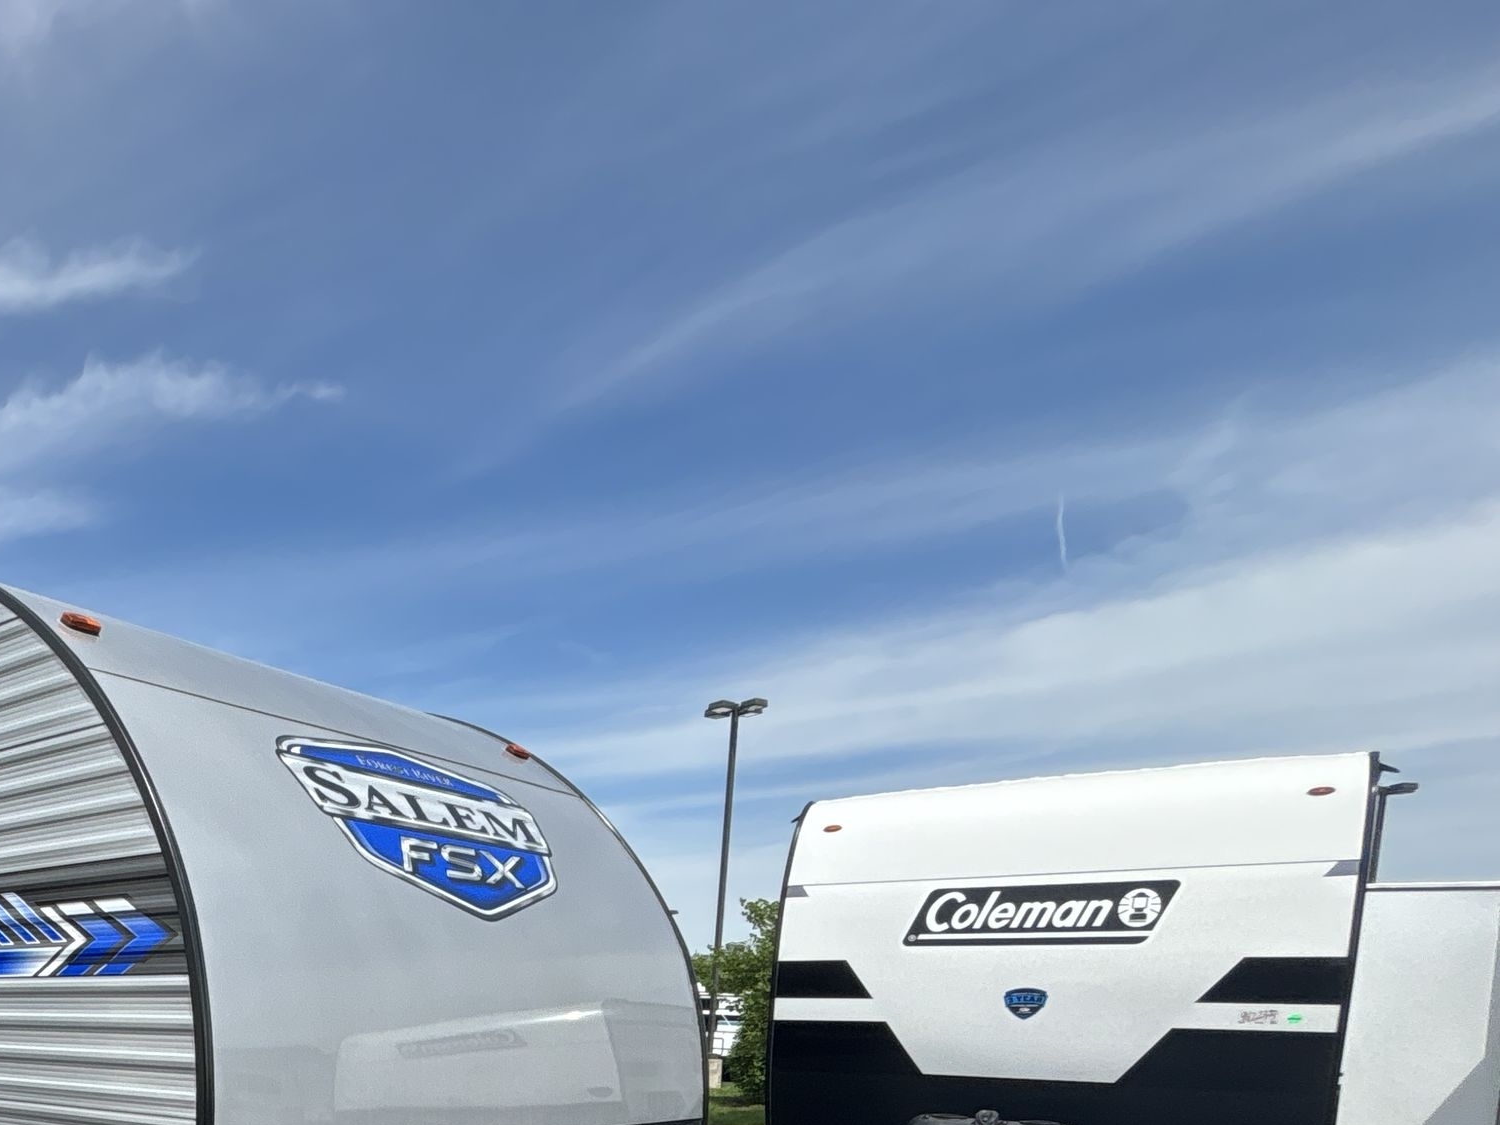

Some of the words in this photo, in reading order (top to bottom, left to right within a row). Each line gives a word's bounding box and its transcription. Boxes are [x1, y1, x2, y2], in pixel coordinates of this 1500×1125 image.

[411, 767, 454, 787] RIVER
[302, 765, 543, 845] SALEM
[400, 835, 526, 889] FSX
[925, 890, 1114, 933] Coleman
